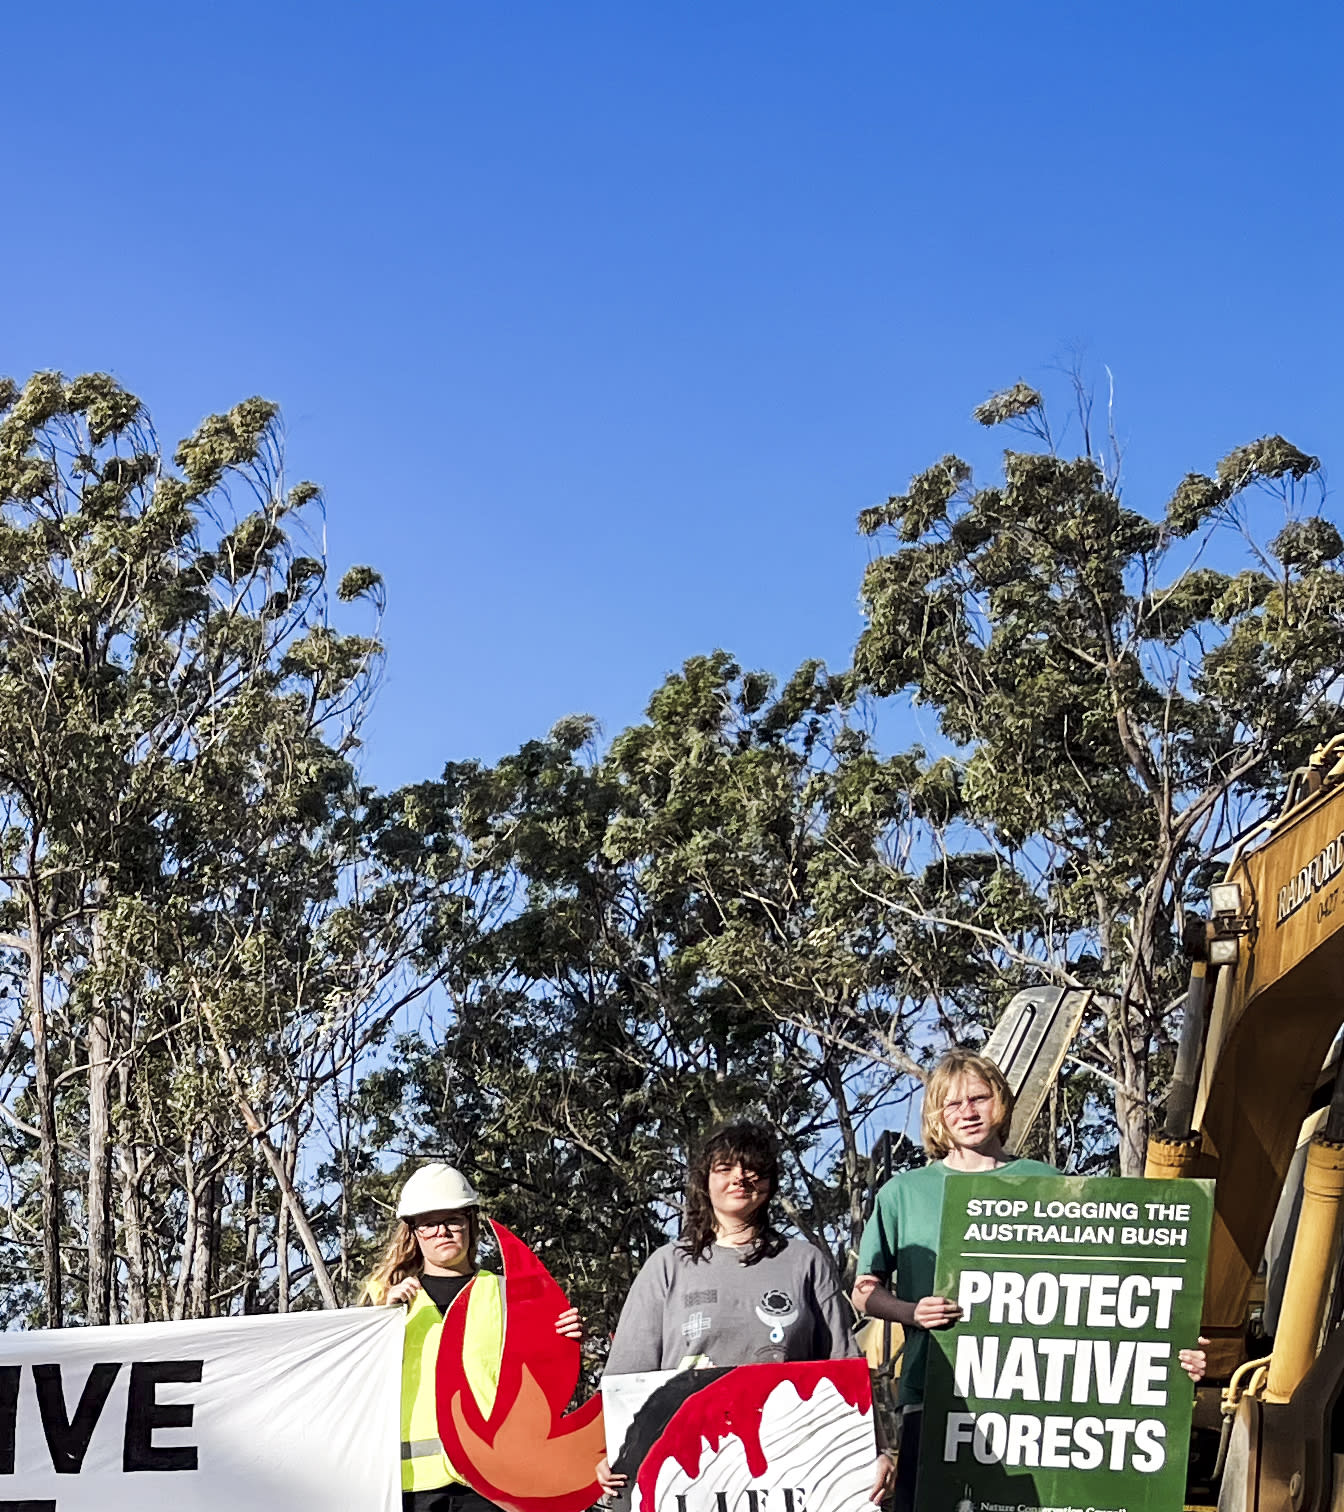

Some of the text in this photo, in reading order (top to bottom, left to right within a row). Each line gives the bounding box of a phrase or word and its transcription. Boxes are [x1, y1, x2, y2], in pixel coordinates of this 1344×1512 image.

[966, 1199, 1190, 1221] STOP LOGGING THE
[963, 1223, 1187, 1246] AUSTRALIAN BUSH
[958, 1270, 1183, 1329] PROTECT
[953, 1335, 1171, 1407] NATIVE
[943, 1411, 1167, 1473] FORESTS
[980, 1502, 1015, 1512] Nature
